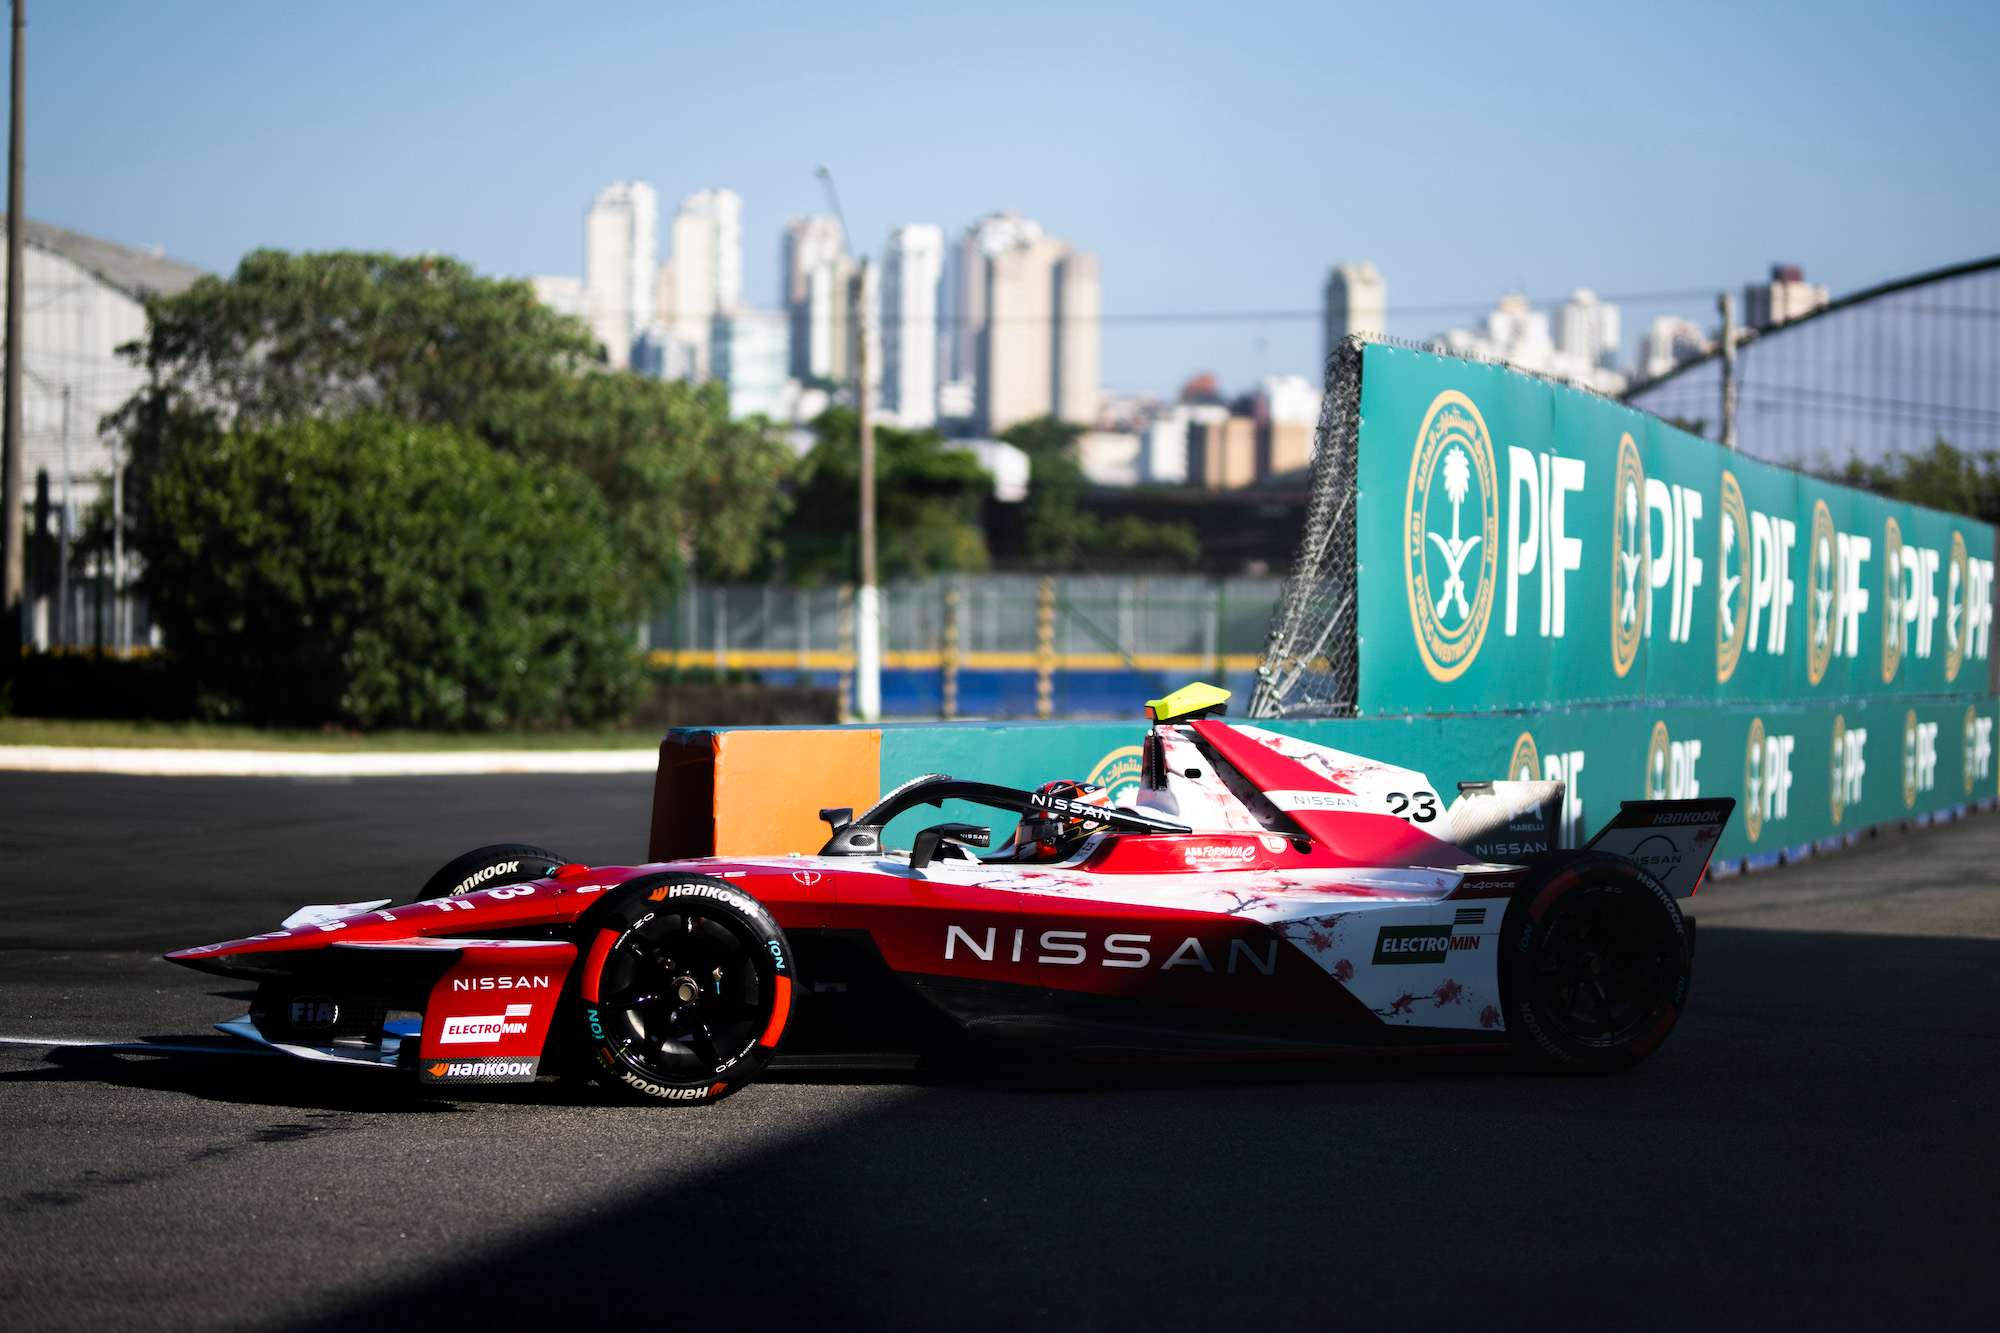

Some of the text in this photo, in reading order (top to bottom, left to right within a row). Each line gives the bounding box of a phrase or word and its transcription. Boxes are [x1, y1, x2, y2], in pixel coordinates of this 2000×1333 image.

[1505, 445, 1586, 637] PIF
[1644, 477, 1704, 643] PIF
[1747, 510, 1796, 656] PIF
[1832, 531, 1872, 658] PIF
[1900, 544, 1940, 659] PIF
[1964, 556, 1995, 660] PIF
[1763, 735, 1795, 822] PIF
[1844, 728, 1867, 805] PIF
[1915, 721, 1938, 792] PIF
[1031, 793, 1112, 821] NISSAN
[1293, 795, 1359, 808] NISSAN
[1386, 791, 1437, 823] 23
[960, 833, 989, 841] NISSAN
[1475, 842, 1549, 856] NISSAN
[1509, 823, 1545, 832] MARELLI
[944, 925, 1280, 976] NISSAN
[1381, 935, 1481, 953] ELECTROMIN
[453, 975, 549, 992] NISSAN
[448, 1022, 528, 1035] ELECTROMIN
